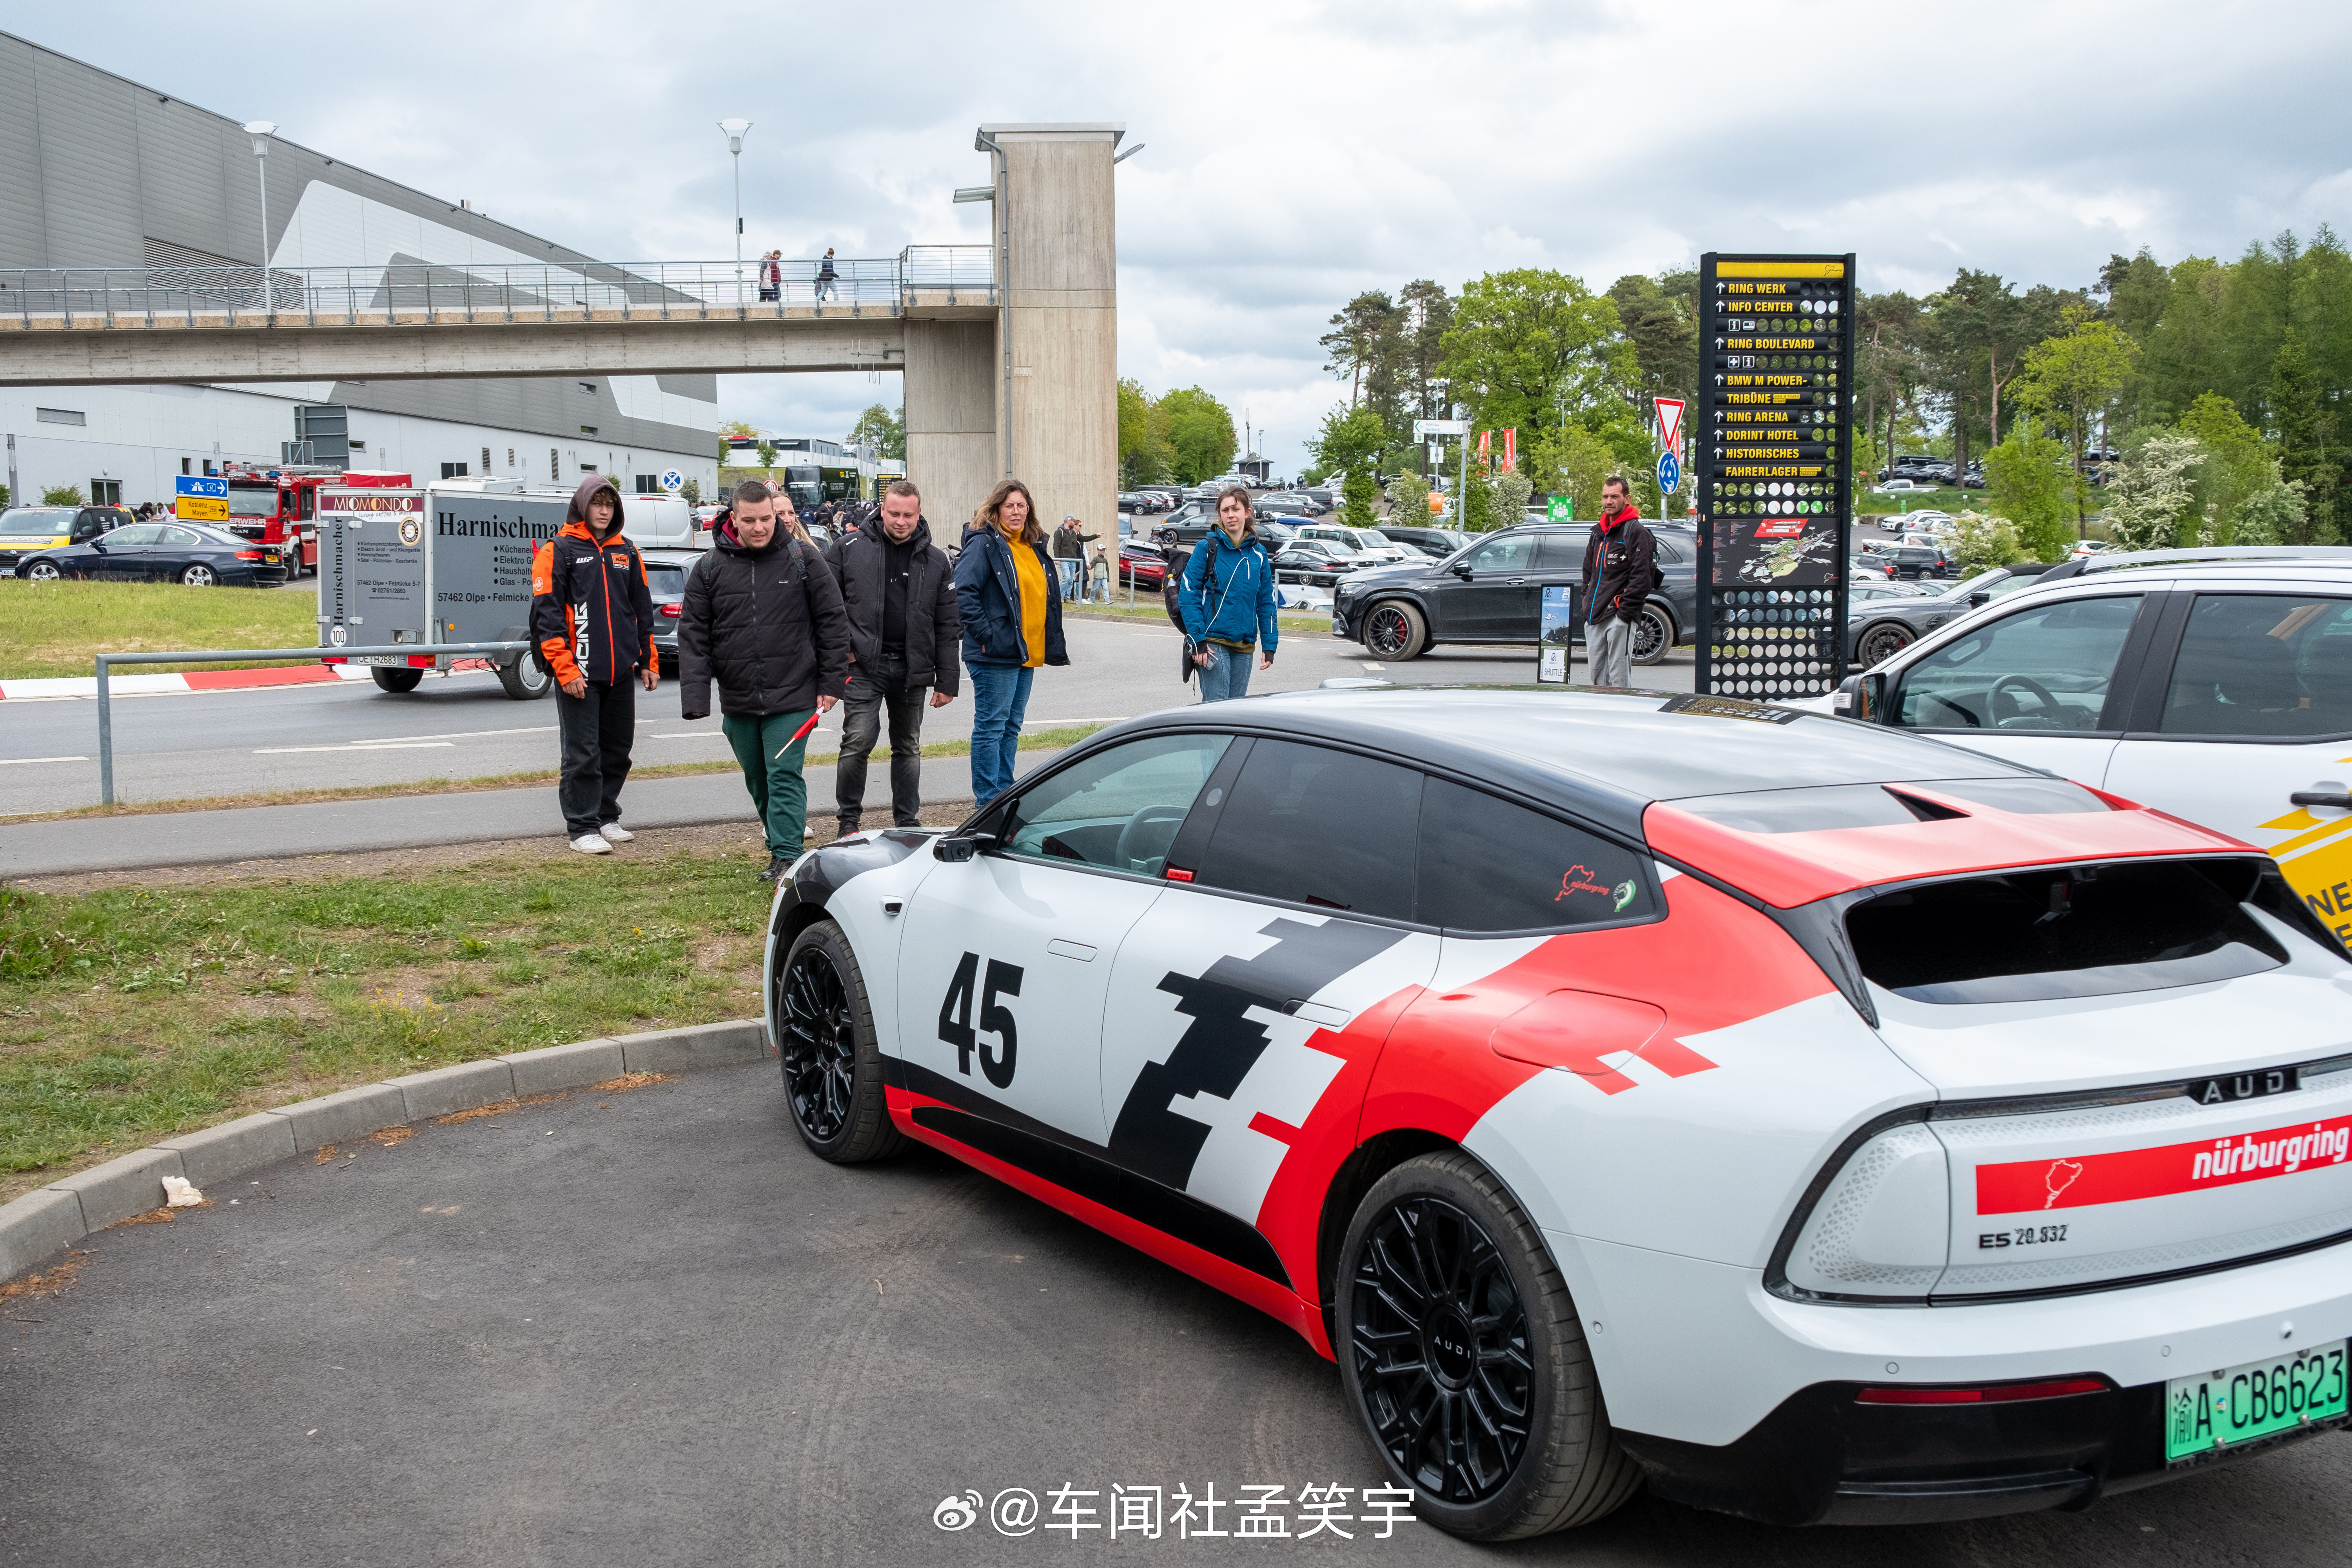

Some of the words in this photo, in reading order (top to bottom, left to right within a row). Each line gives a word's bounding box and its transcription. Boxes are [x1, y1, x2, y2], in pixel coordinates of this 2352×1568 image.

[1728, 283, 1753, 294] RING
[1757, 284, 1786, 294] WERK
[1728, 302, 1753, 312] INFO
[1755, 302, 1793, 312] CENTER
[1727, 339, 1753, 349] RING
[1755, 339, 1815, 349] BOULEVARD
[1727, 376, 1752, 385] BMW
[1755, 376, 1764, 385] M
[1767, 376, 1807, 386] POWER-
[1727, 392, 1771, 403] TRIBÜNE
[1727, 412, 1751, 422] RING
[1754, 412, 1788, 422] ARENA
[1726, 430, 1764, 440] DORINT
[1767, 430, 1799, 440] HOTEL
[1726, 448, 1799, 458] HISTORISCHES
[1726, 466, 1797, 476] FAHRERLAGER
[334, 497, 413, 511] MIOMONDO
[192, 509, 208, 517] Mayen
[437, 512, 565, 539] Harnischma
[500, 556, 524, 564] Elektro
[333, 516, 343, 626] Harnischmacher
[500, 577, 515, 586] Glas
[437, 593, 463, 602] 57462
[466, 593, 485, 604] Olpe
[493, 593, 529, 602] Felmicke
[332, 630, 345, 643] 100
[574, 601, 589, 681] ACING
[374, 656, 396, 664] H2683
[1544, 668, 1563, 677] SHUTTLE
[1570, 880, 1610, 896] nürburgring
[938, 951, 1025, 1090] 45
[821, 1037, 836, 1049] AUDI
[2202, 1067, 2303, 1103] AUDI
[2192, 1123, 2350, 1180] nürburgring
[1979, 1232, 2011, 1249] E5
[1434, 1336, 1470, 1359] AUDI
[2173, 1383, 2212, 1445] 渝A
[2231, 1348, 2343, 1429] CB6623
